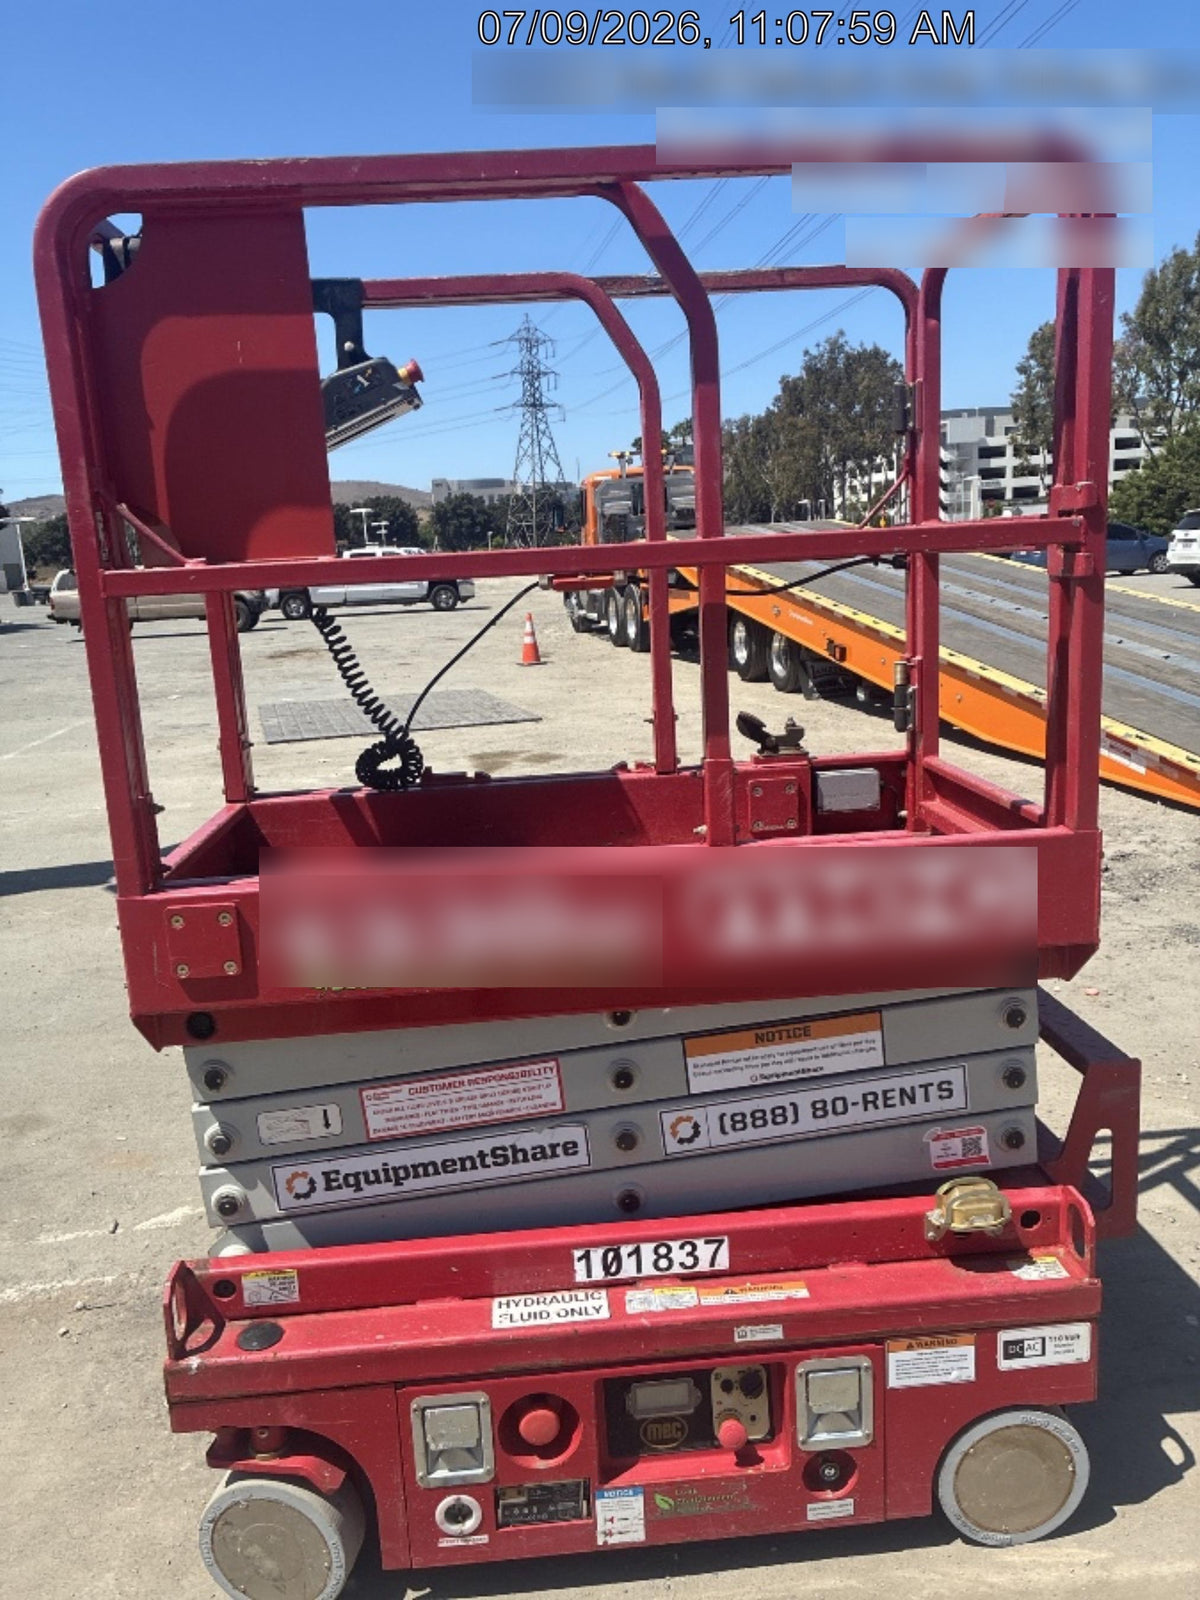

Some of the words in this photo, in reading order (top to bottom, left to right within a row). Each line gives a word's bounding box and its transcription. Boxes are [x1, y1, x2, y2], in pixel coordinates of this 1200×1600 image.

[754, 1025, 812, 1044] NOTICE
[408, 1080, 465, 1096] CUSTOMER
[719, 1101, 799, 1136] (888)
[810, 1080, 954, 1120] 80-RENTS
[321, 1139, 580, 1193] EquipmentShare
[576, 1238, 727, 1279] 101837
[498, 1290, 602, 1309] HYDRAULIC
[556, 1305, 603, 1318] ONLY
[1008, 1342, 1024, 1354] DC
[1025, 1341, 1039, 1353] AC
